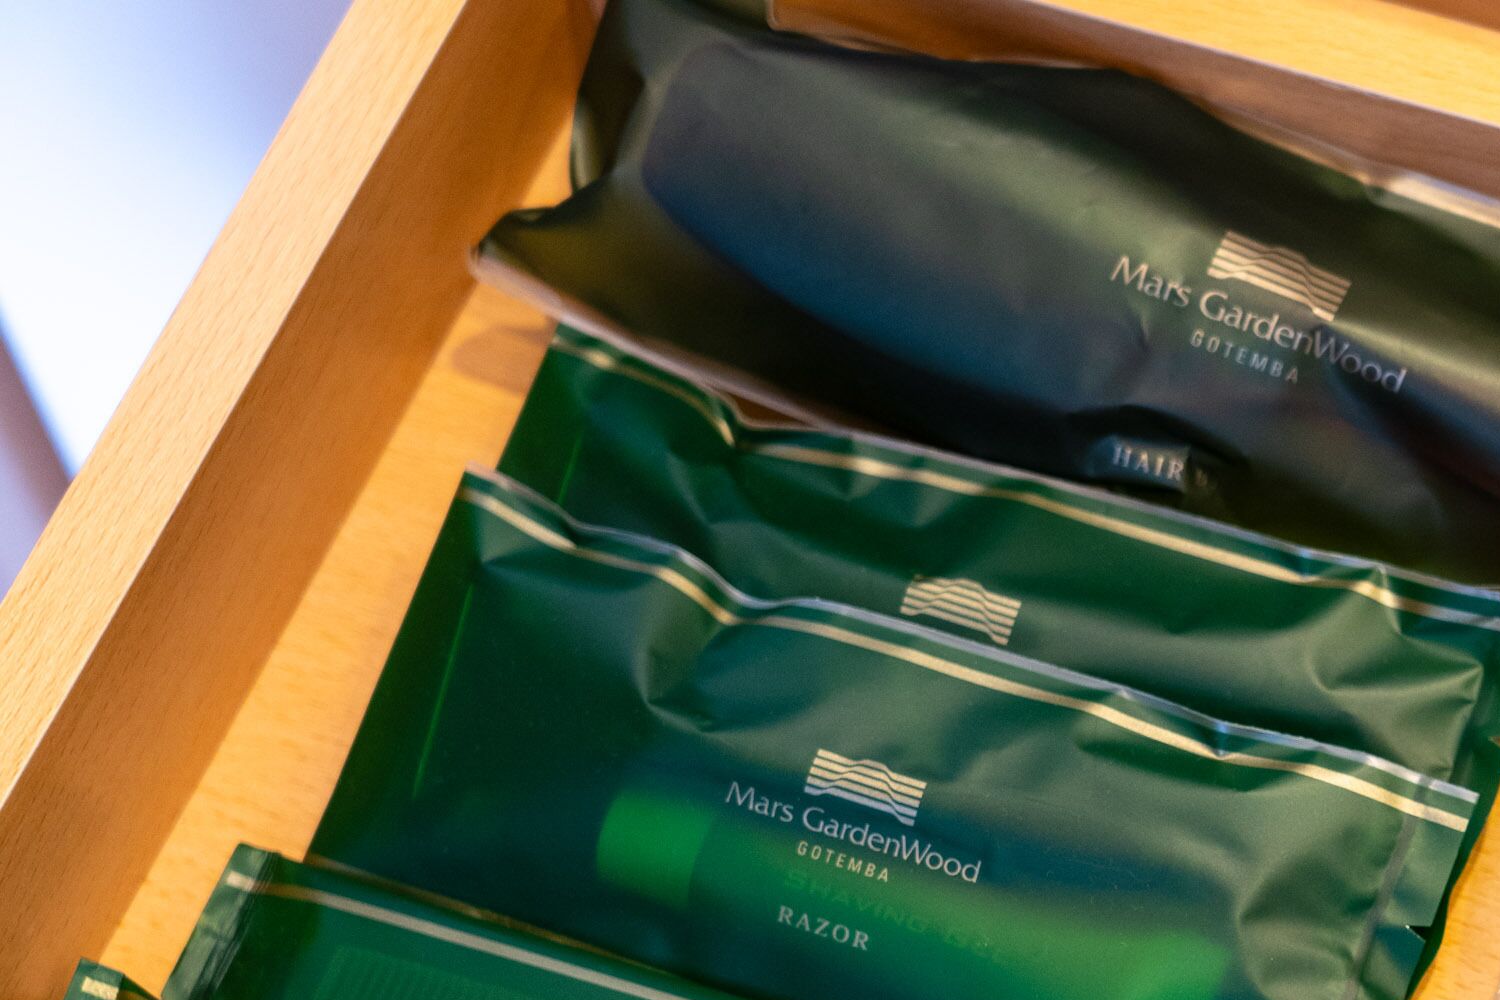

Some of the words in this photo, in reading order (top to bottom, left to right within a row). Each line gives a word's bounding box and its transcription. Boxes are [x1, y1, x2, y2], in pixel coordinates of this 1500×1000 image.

[1110, 255, 1192, 308] Mars
[1199, 288, 1409, 394] GardenWood
[1189, 328, 1300, 385] GOTEMBA
[1111, 443, 1185, 482] HAIR
[725, 781, 794, 824] Mars
[802, 806, 983, 884] GardenWood
[796, 839, 890, 884] GOTEMBA
[776, 903, 872, 952] RAZOR
